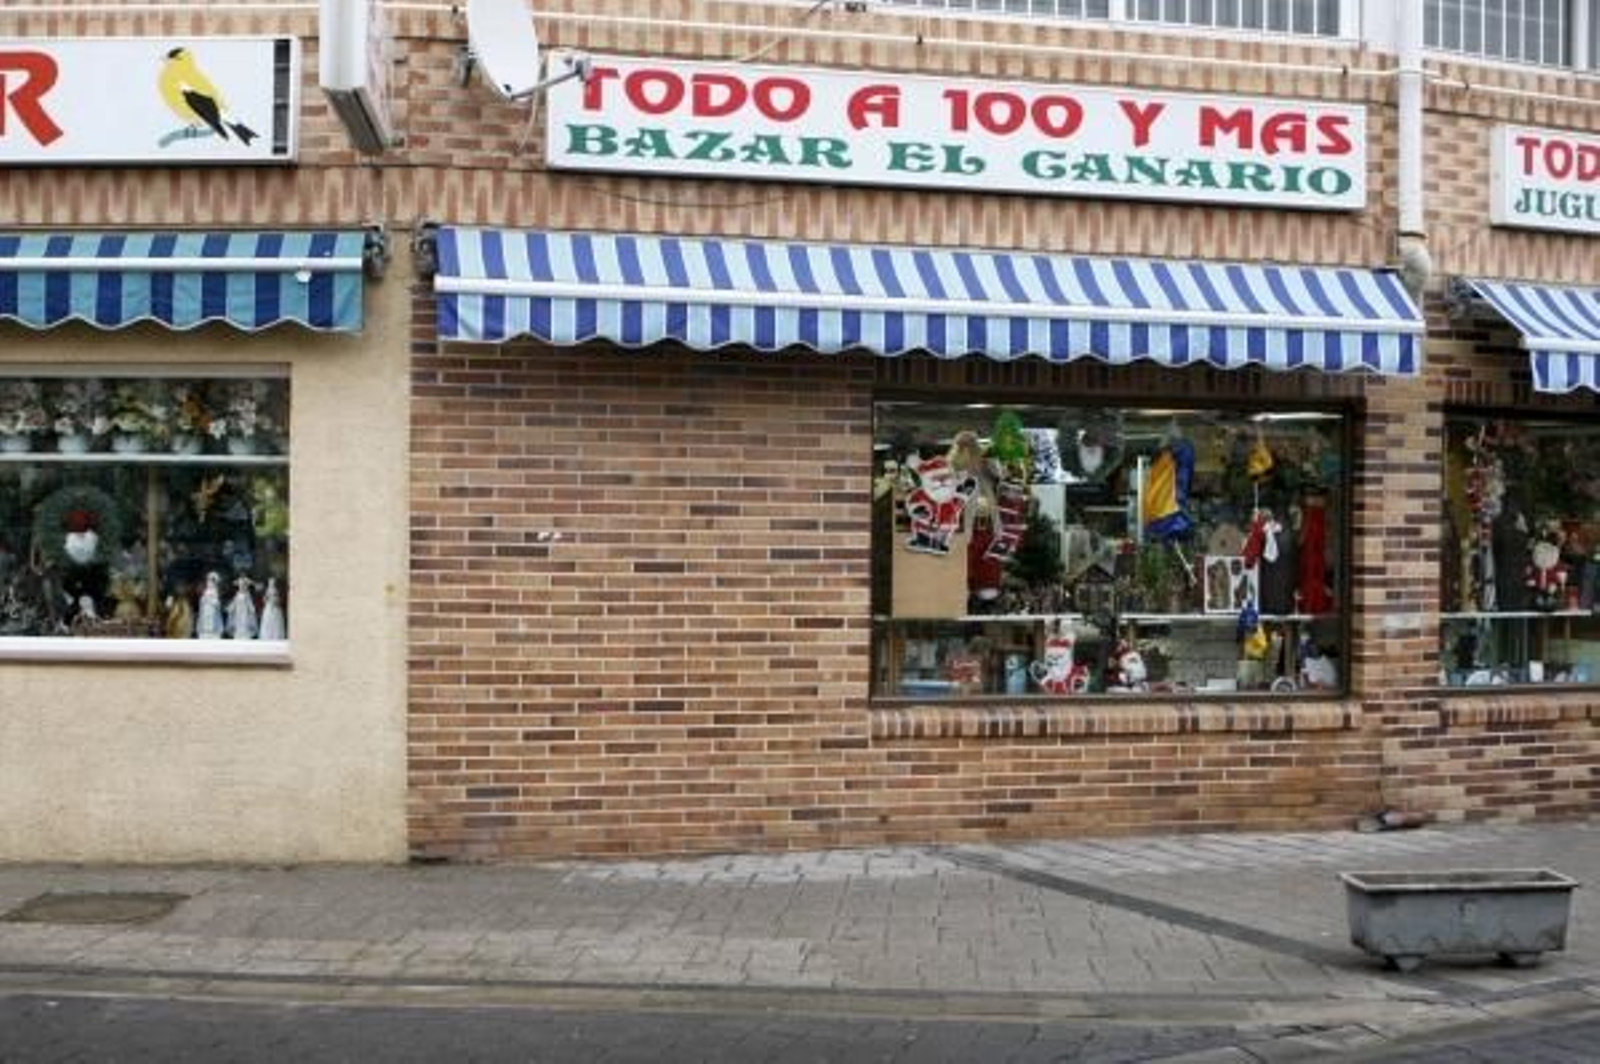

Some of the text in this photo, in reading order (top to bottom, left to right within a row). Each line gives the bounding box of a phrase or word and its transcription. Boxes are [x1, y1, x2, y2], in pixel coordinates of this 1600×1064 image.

[580, 66, 1353, 156] TODO A 100 Y MAS
[566, 123, 854, 170] BAZAR
[887, 141, 987, 176] EL
